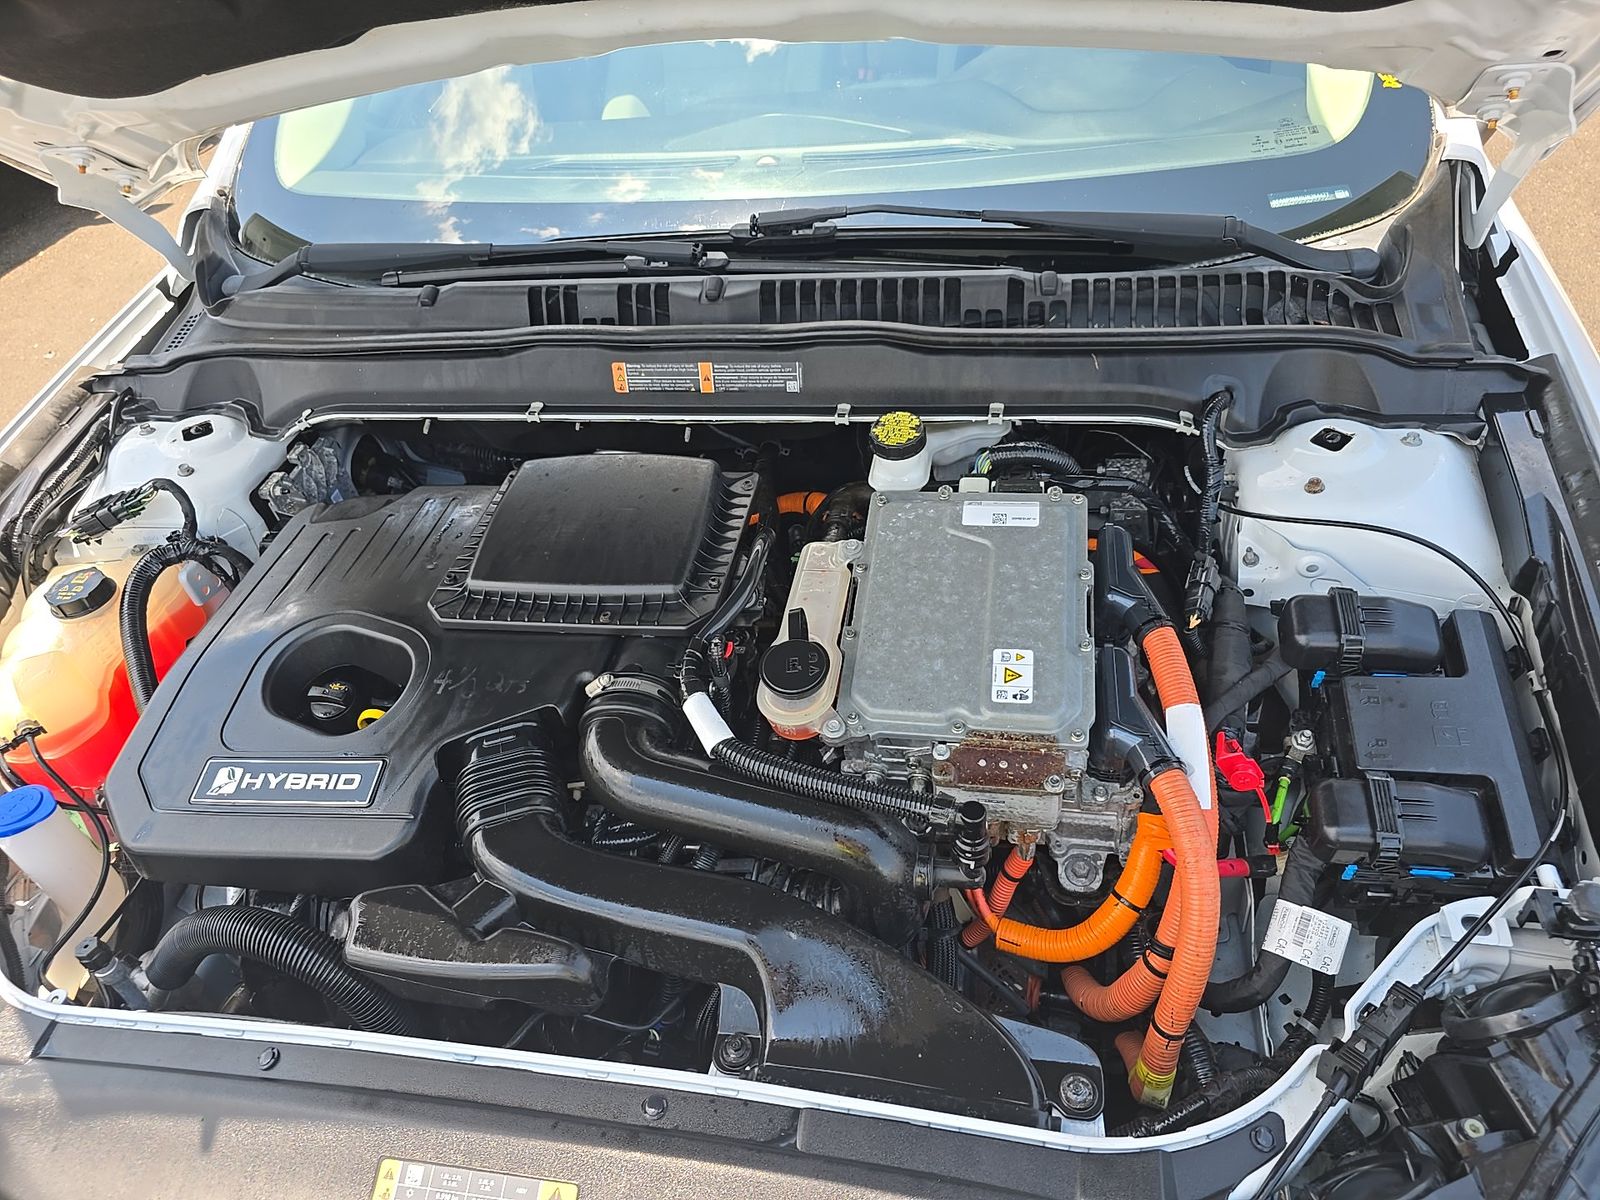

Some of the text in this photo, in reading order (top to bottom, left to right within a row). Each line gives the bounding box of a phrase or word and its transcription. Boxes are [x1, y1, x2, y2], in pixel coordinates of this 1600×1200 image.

[240, 772, 362, 790] HYBRID
[1274, 938, 1288, 954] CAC
[1300, 948, 1312, 965] CAC
[1320, 956, 1332, 972] CAC
